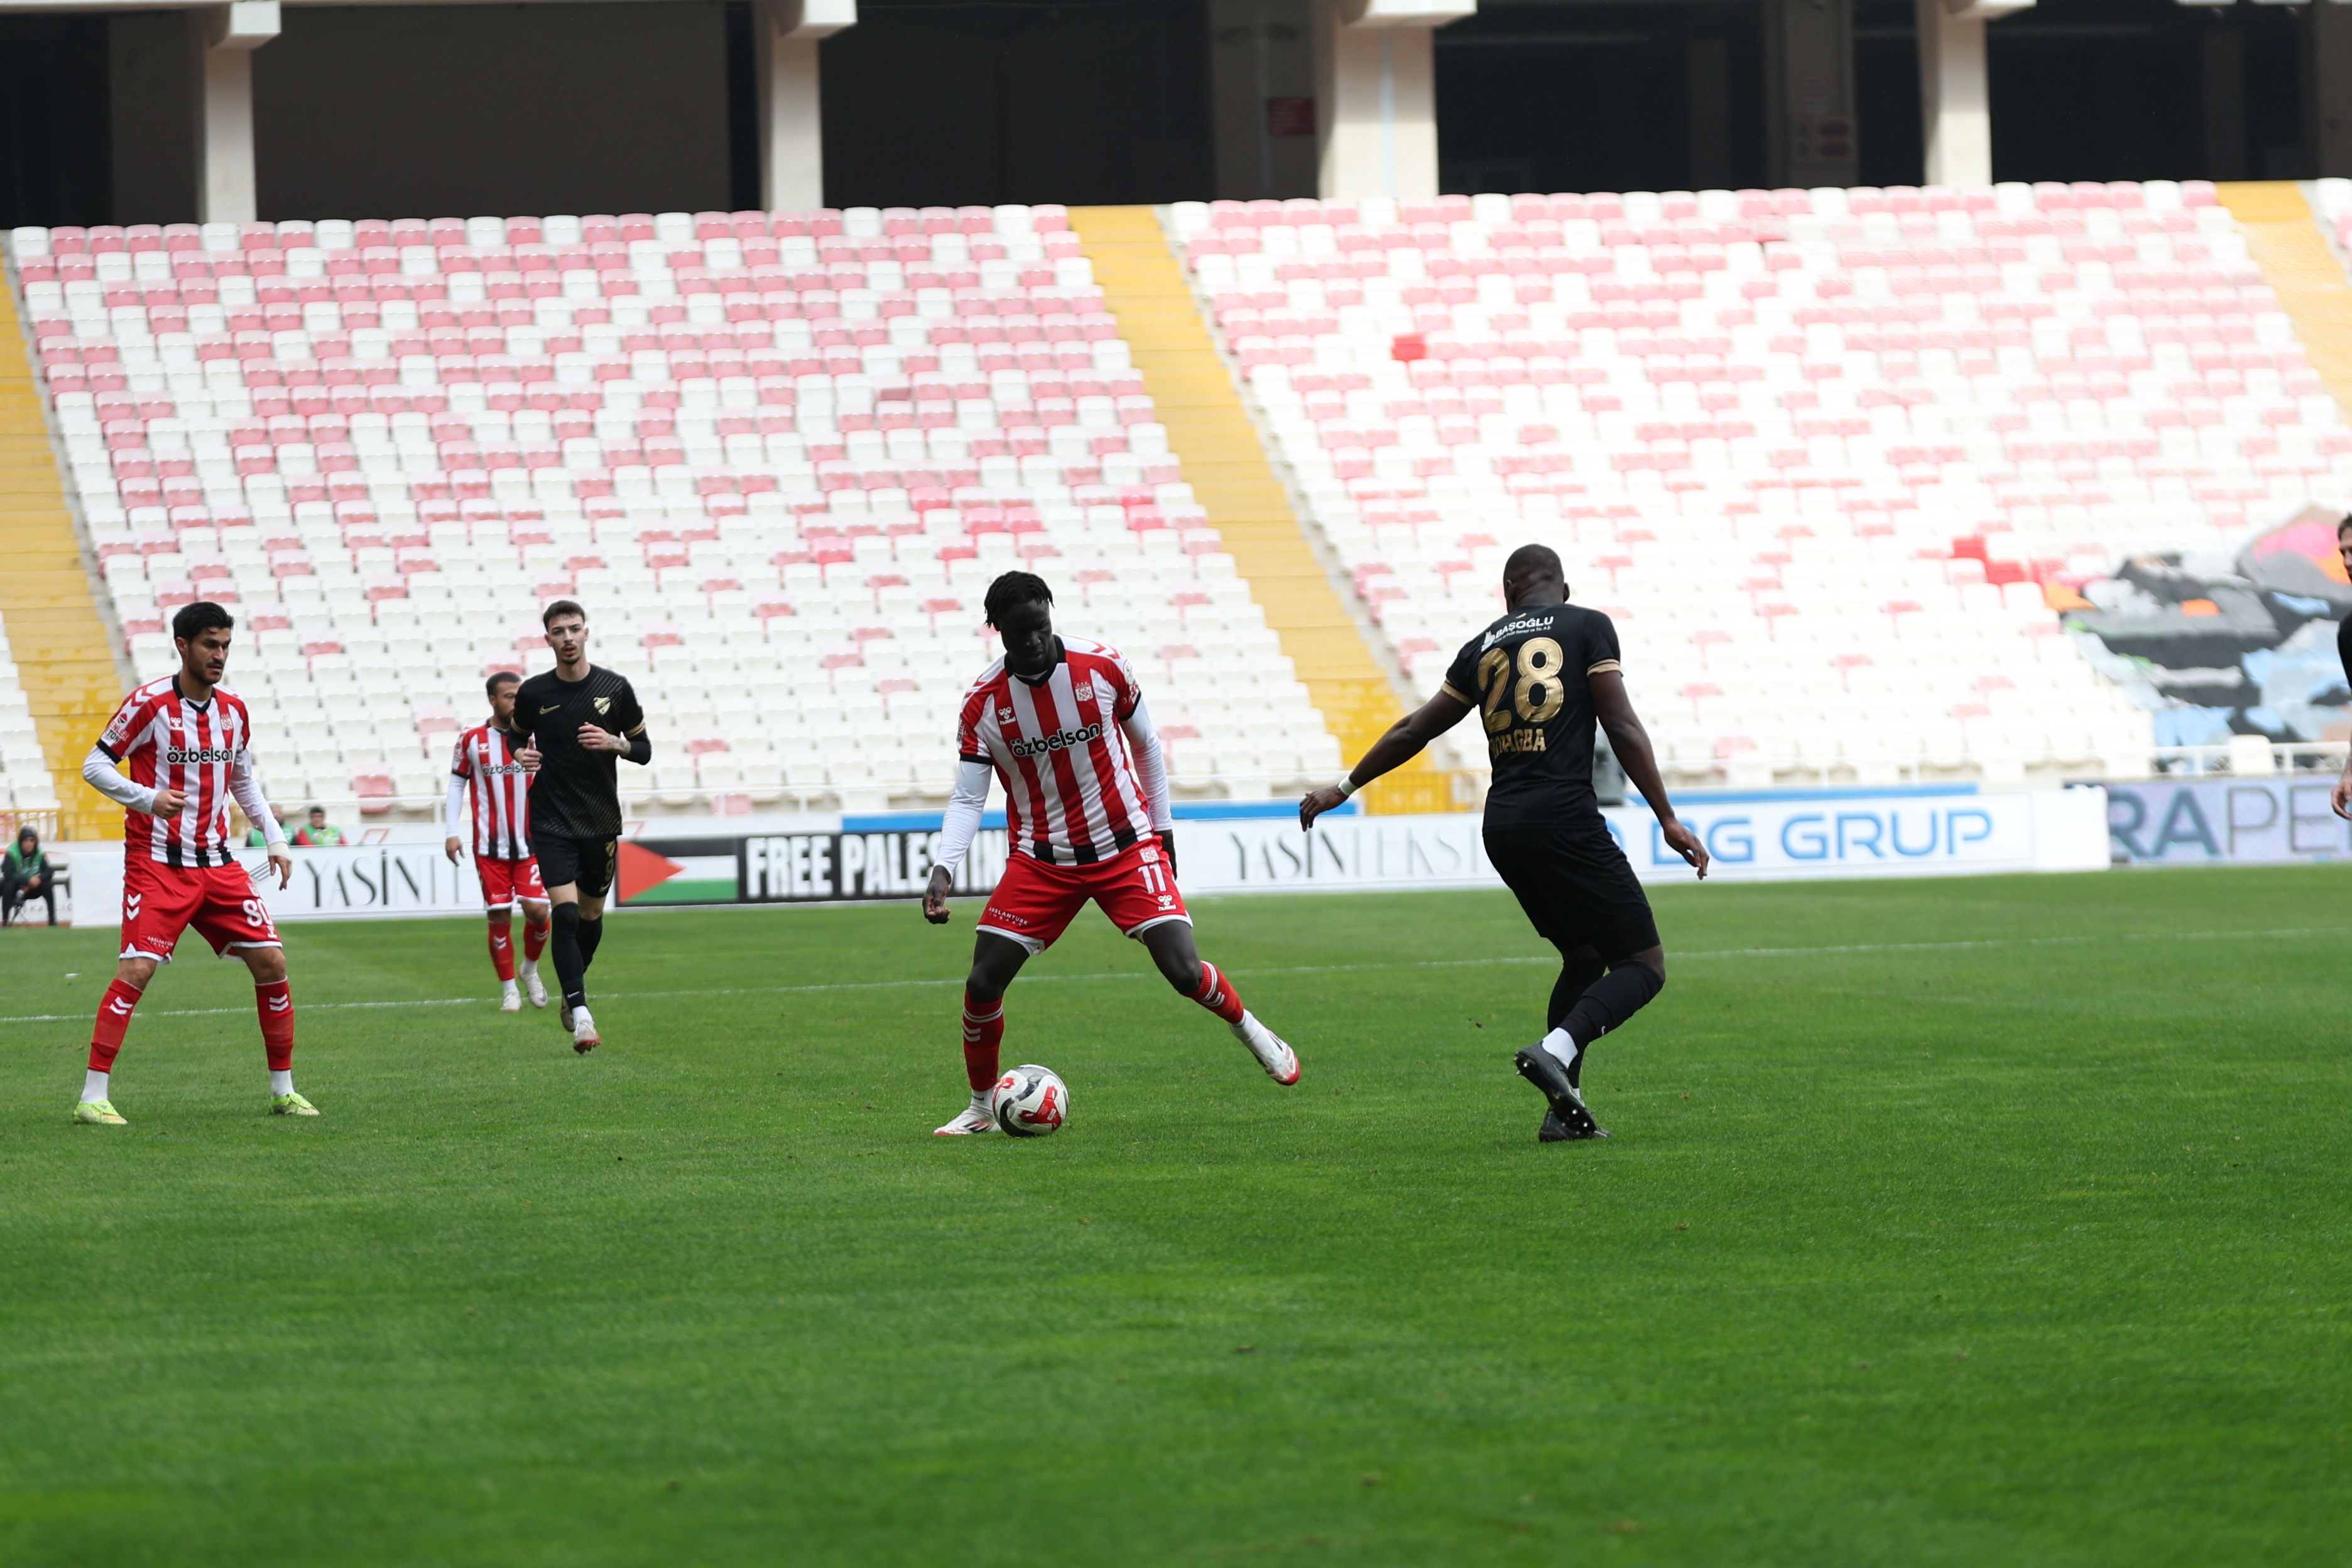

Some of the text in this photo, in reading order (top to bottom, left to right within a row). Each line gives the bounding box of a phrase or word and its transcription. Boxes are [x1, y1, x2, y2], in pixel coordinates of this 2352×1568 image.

[1495, 616, 1554, 639] BAŞOĞLU
[1478, 637, 1564, 733] 28
[107, 720, 129, 741] ENLER
[1010, 723, 1100, 757] özbelsan
[166, 746, 233, 764] özbelsan
[482, 760, 527, 776] özbels
[1780, 808, 1993, 861] GRUP
[2107, 783, 2352, 858] RAPE
[746, 835, 833, 899] FREE
[1138, 862, 1167, 894] 11
[242, 898, 274, 927] 80
